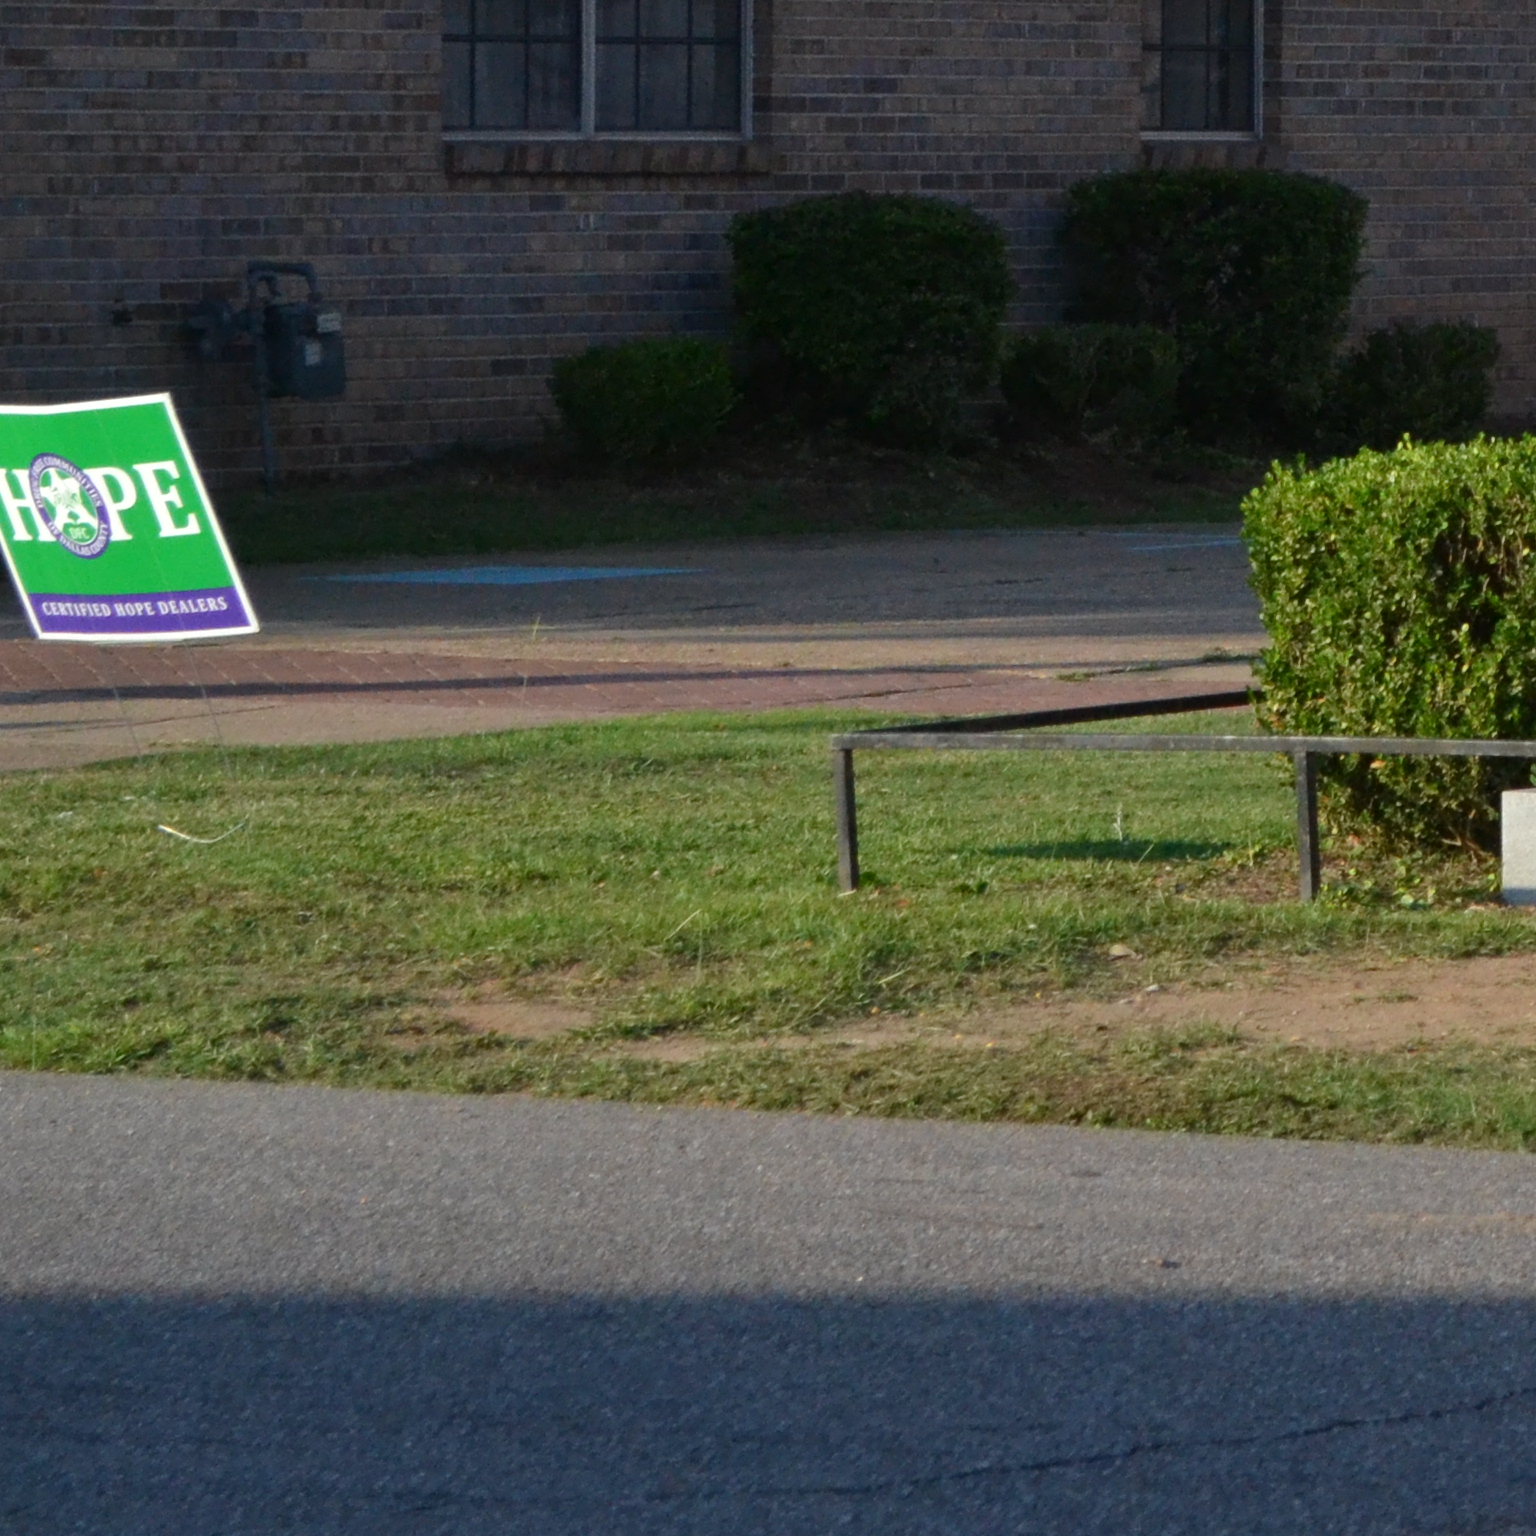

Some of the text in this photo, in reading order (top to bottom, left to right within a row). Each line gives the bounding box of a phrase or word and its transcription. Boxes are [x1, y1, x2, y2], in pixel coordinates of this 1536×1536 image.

[42, 596, 228, 617] CERTIFIED HOPE DEALERS
